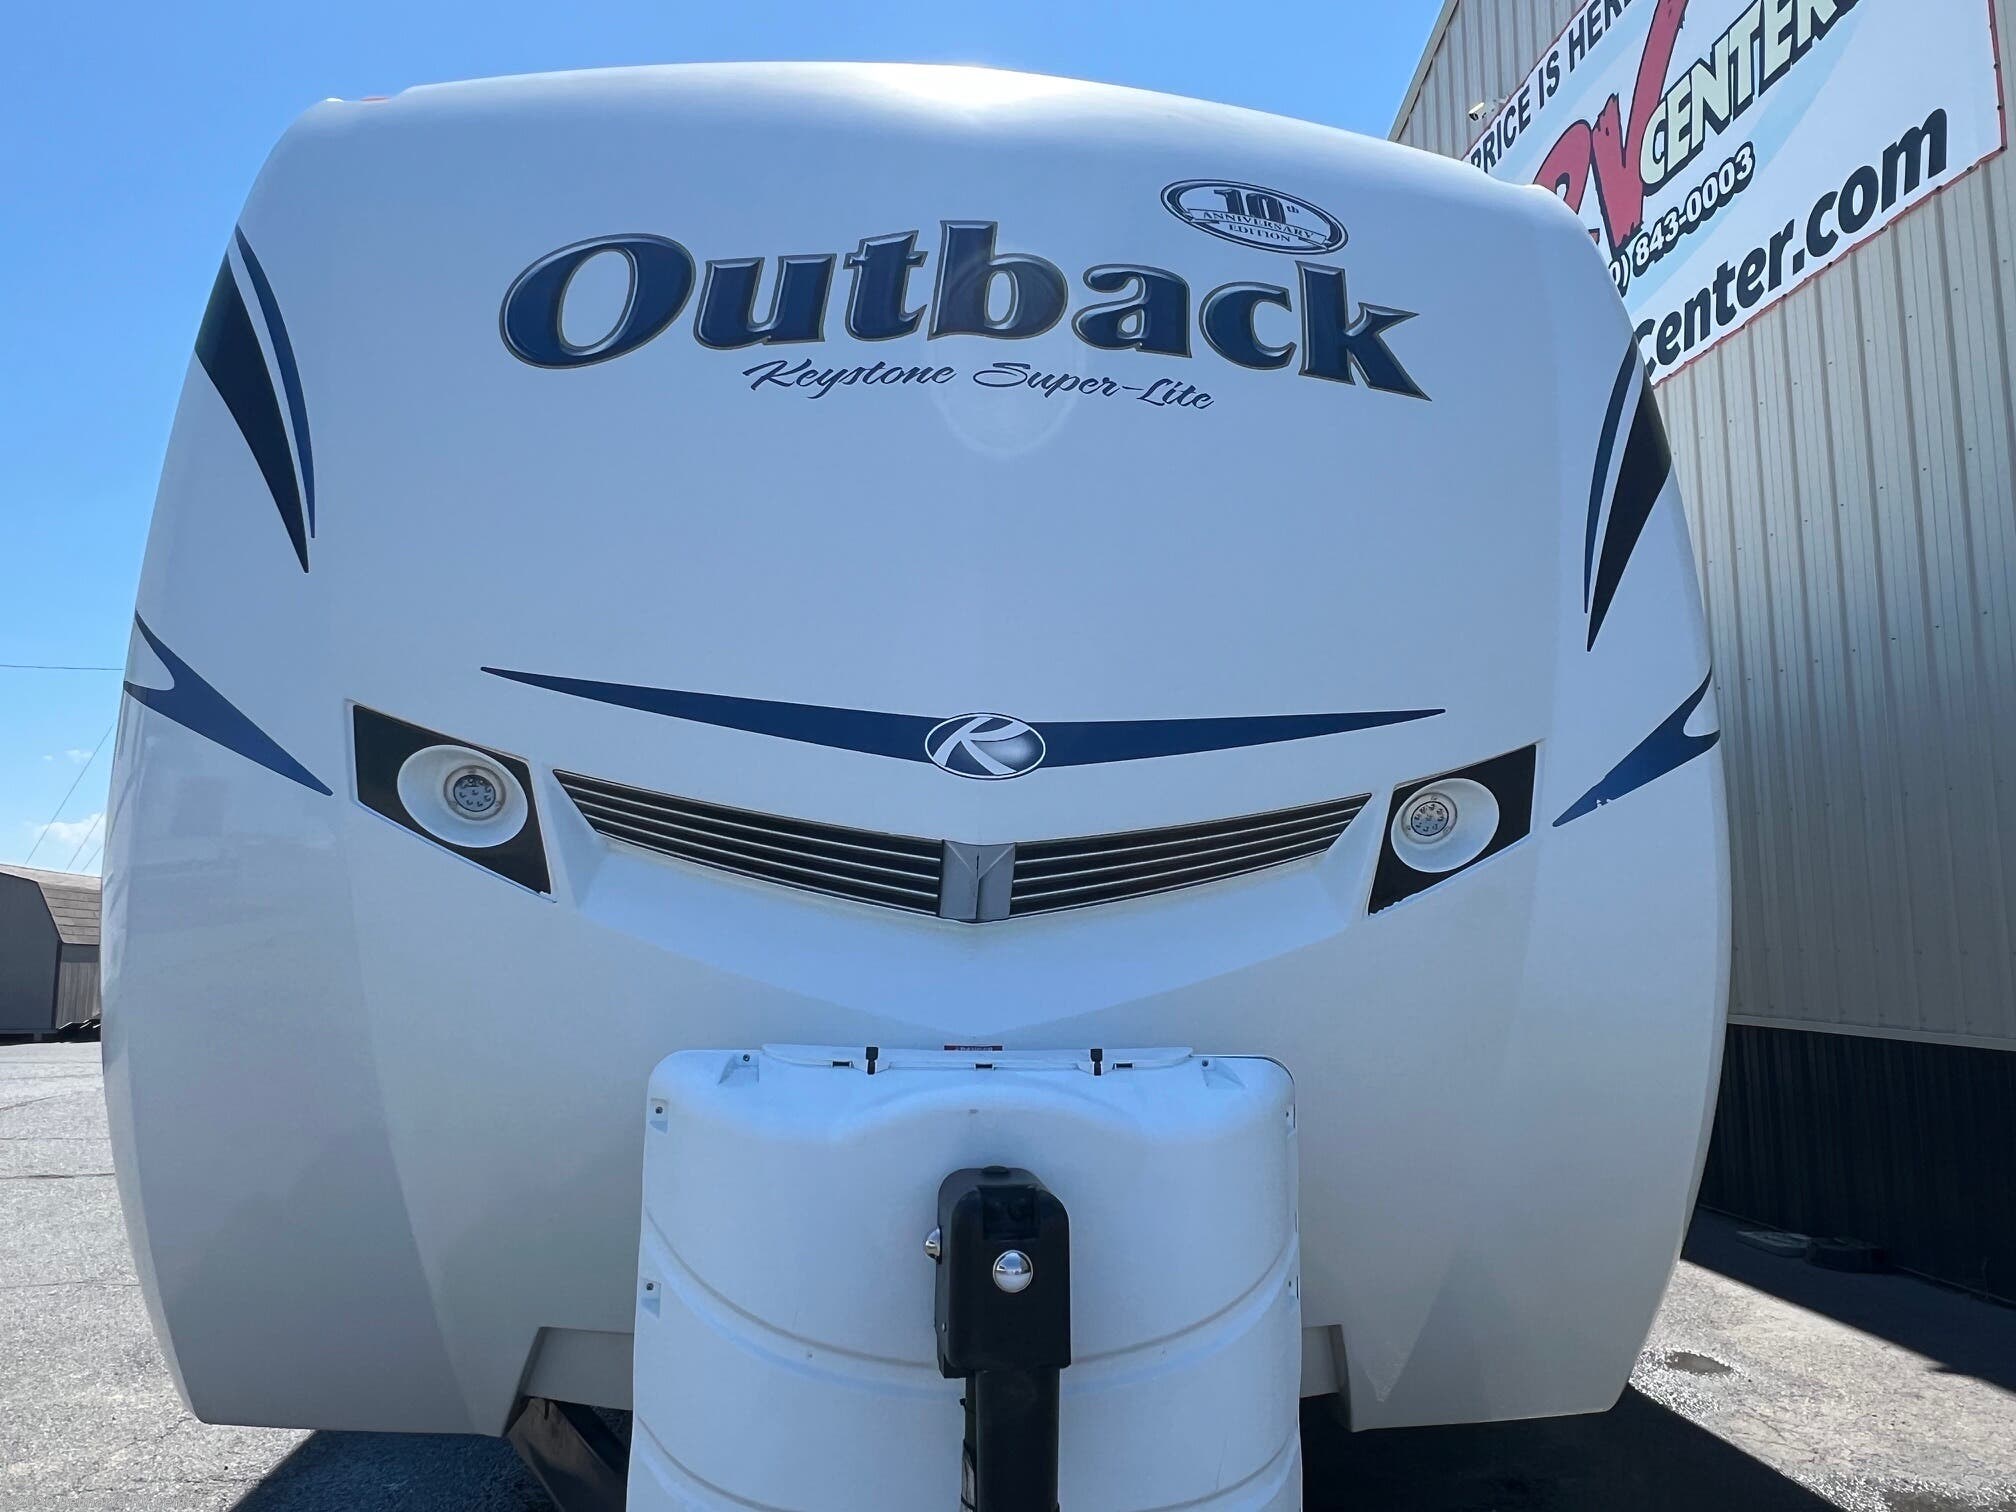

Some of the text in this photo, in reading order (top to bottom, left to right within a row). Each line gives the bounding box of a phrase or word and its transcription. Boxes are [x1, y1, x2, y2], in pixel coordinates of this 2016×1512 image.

[1537, 49, 1561, 110] IS
[1567, 0, 1632, 73] HER
[1203, 211, 1314, 240] ANNIVERSARY
[1228, 223, 1291, 243] EDITION
[1634, 144, 1754, 270] 843-0003
[498, 219, 1432, 402] Outback
[742, 358, 1215, 410] Keystone Super-Lite
